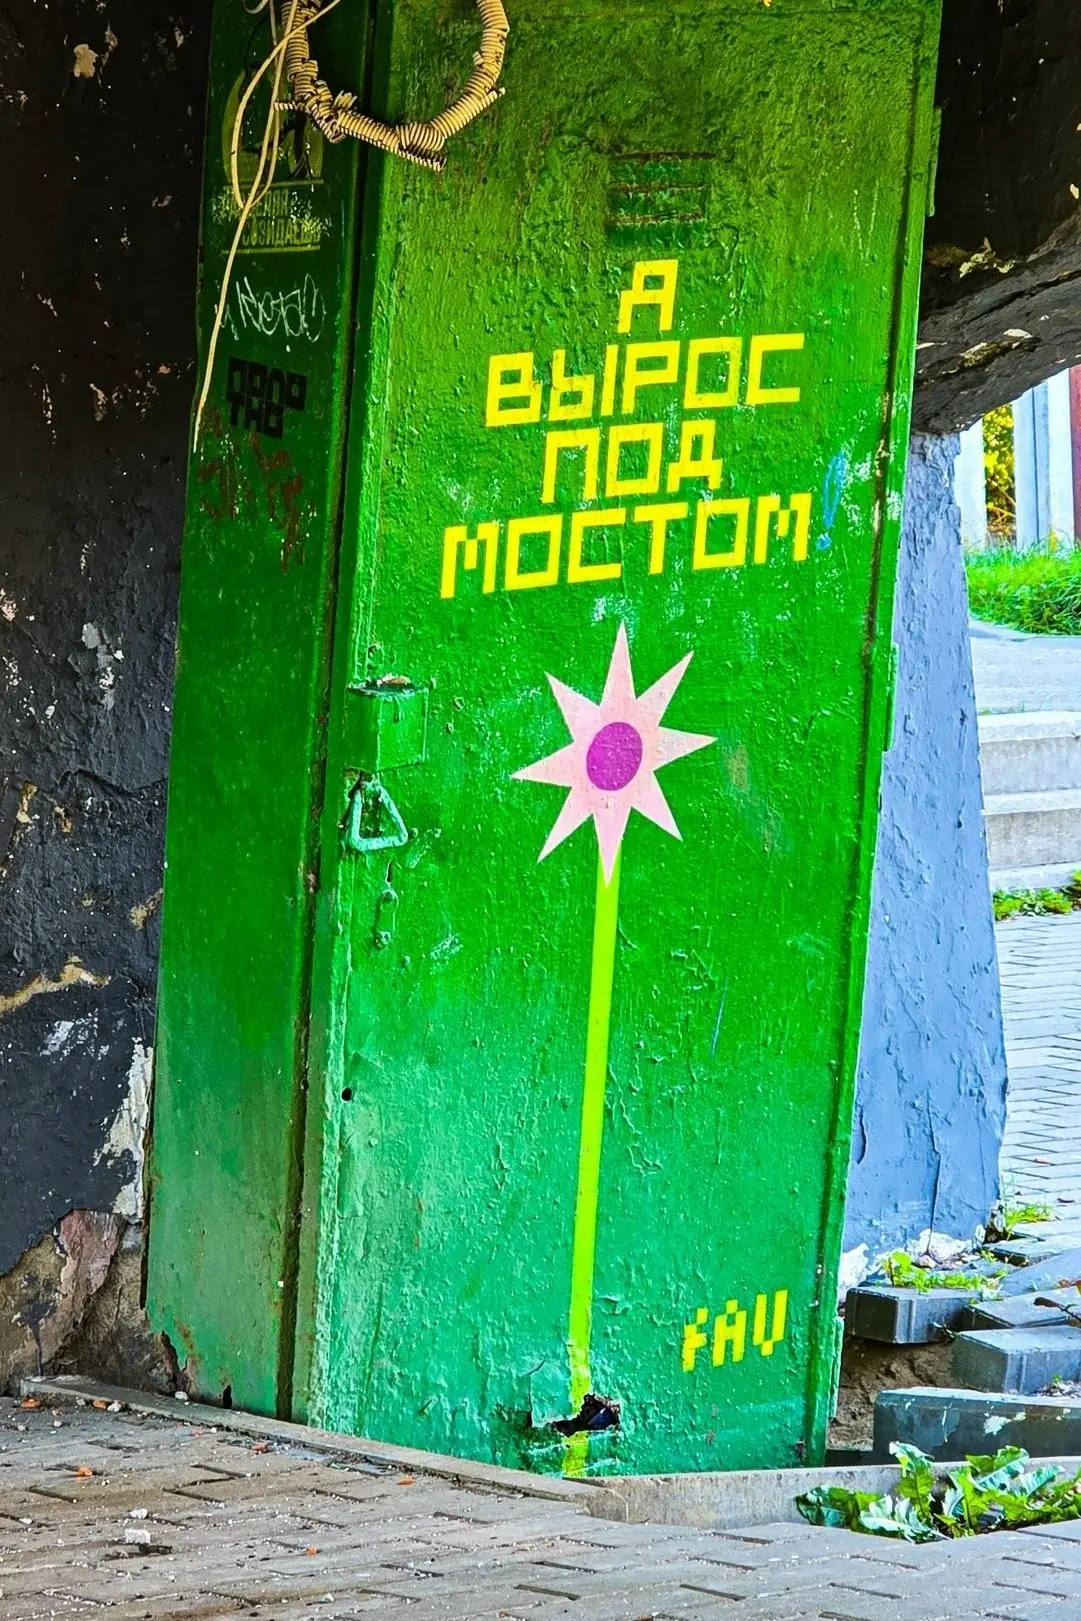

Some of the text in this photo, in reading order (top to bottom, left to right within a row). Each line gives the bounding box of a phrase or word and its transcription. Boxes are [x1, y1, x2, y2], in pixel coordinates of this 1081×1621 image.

[485, 333, 805, 427] ВЫРОС
[541, 419, 723, 504] ПОД
[440, 493, 812, 599] МОСТОМ
